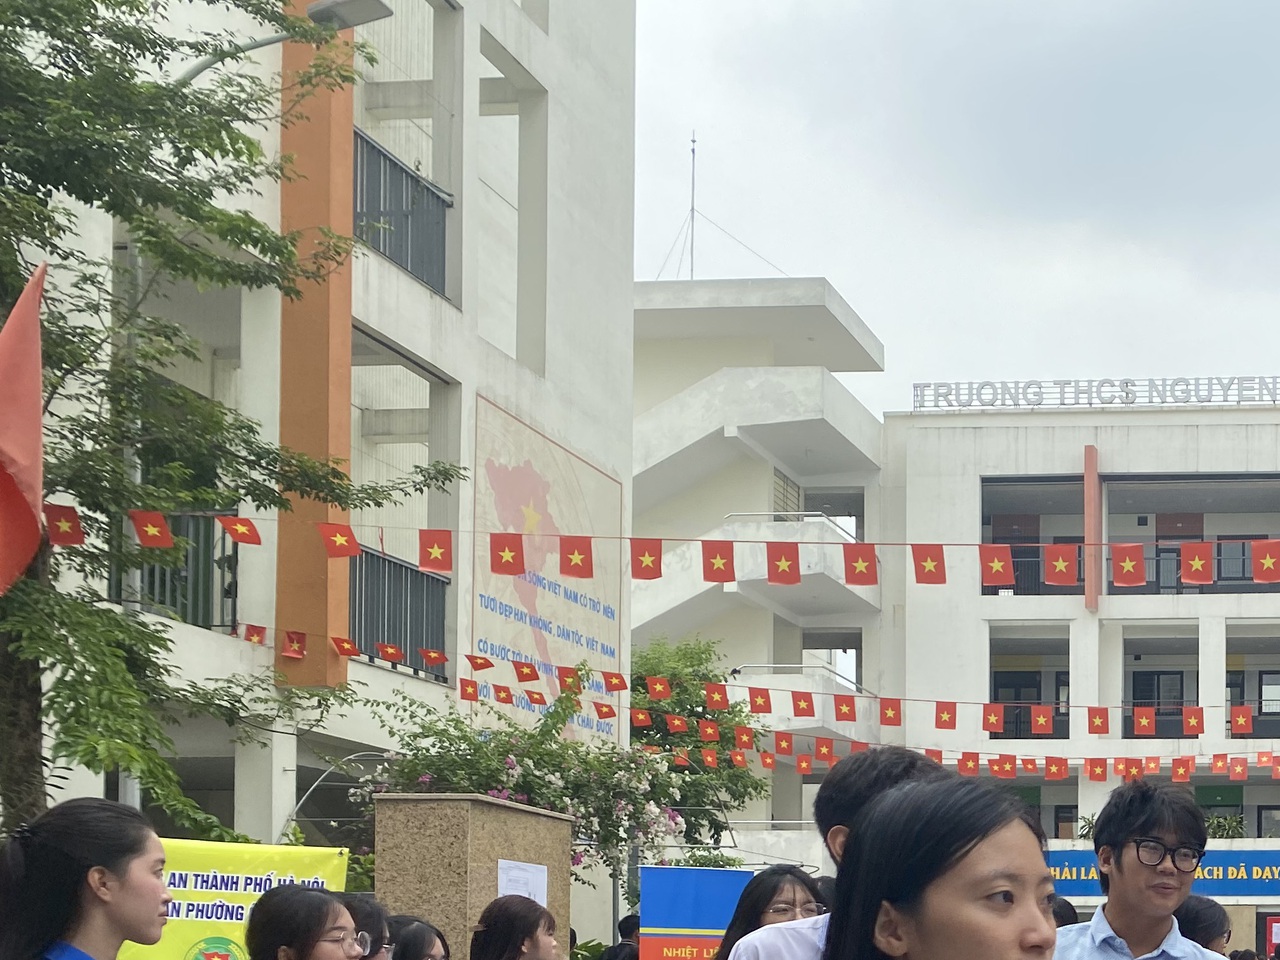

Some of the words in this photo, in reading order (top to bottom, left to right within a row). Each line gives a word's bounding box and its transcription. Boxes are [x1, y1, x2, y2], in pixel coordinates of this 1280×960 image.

[914, 380, 1044, 407] TRUONG
[1053, 378, 1137, 405] THCS
[1148, 376, 1278, 404] NGUYEN
[547, 579, 561, 598] VIỆT
[564, 586, 578, 603] NAM
[579, 593, 587, 608] CÓ
[602, 603, 615, 621] NÊN
[498, 601, 513, 621] ĐẸP
[514, 607, 528, 625] HAY
[585, 636, 598, 655] VIỆT
[601, 642, 615, 659] NAM
[478, 638, 488, 654] CÓ
[1050, 861, 1077, 880] HẢI
[1194, 862, 1223, 880] ÁCH
[1227, 863, 1248, 880] ĐÃ
[193, 871, 239, 892] THÀNH
[185, 901, 245, 921] PHƯỜNG
[663, 946, 698, 959] NHIỆT
